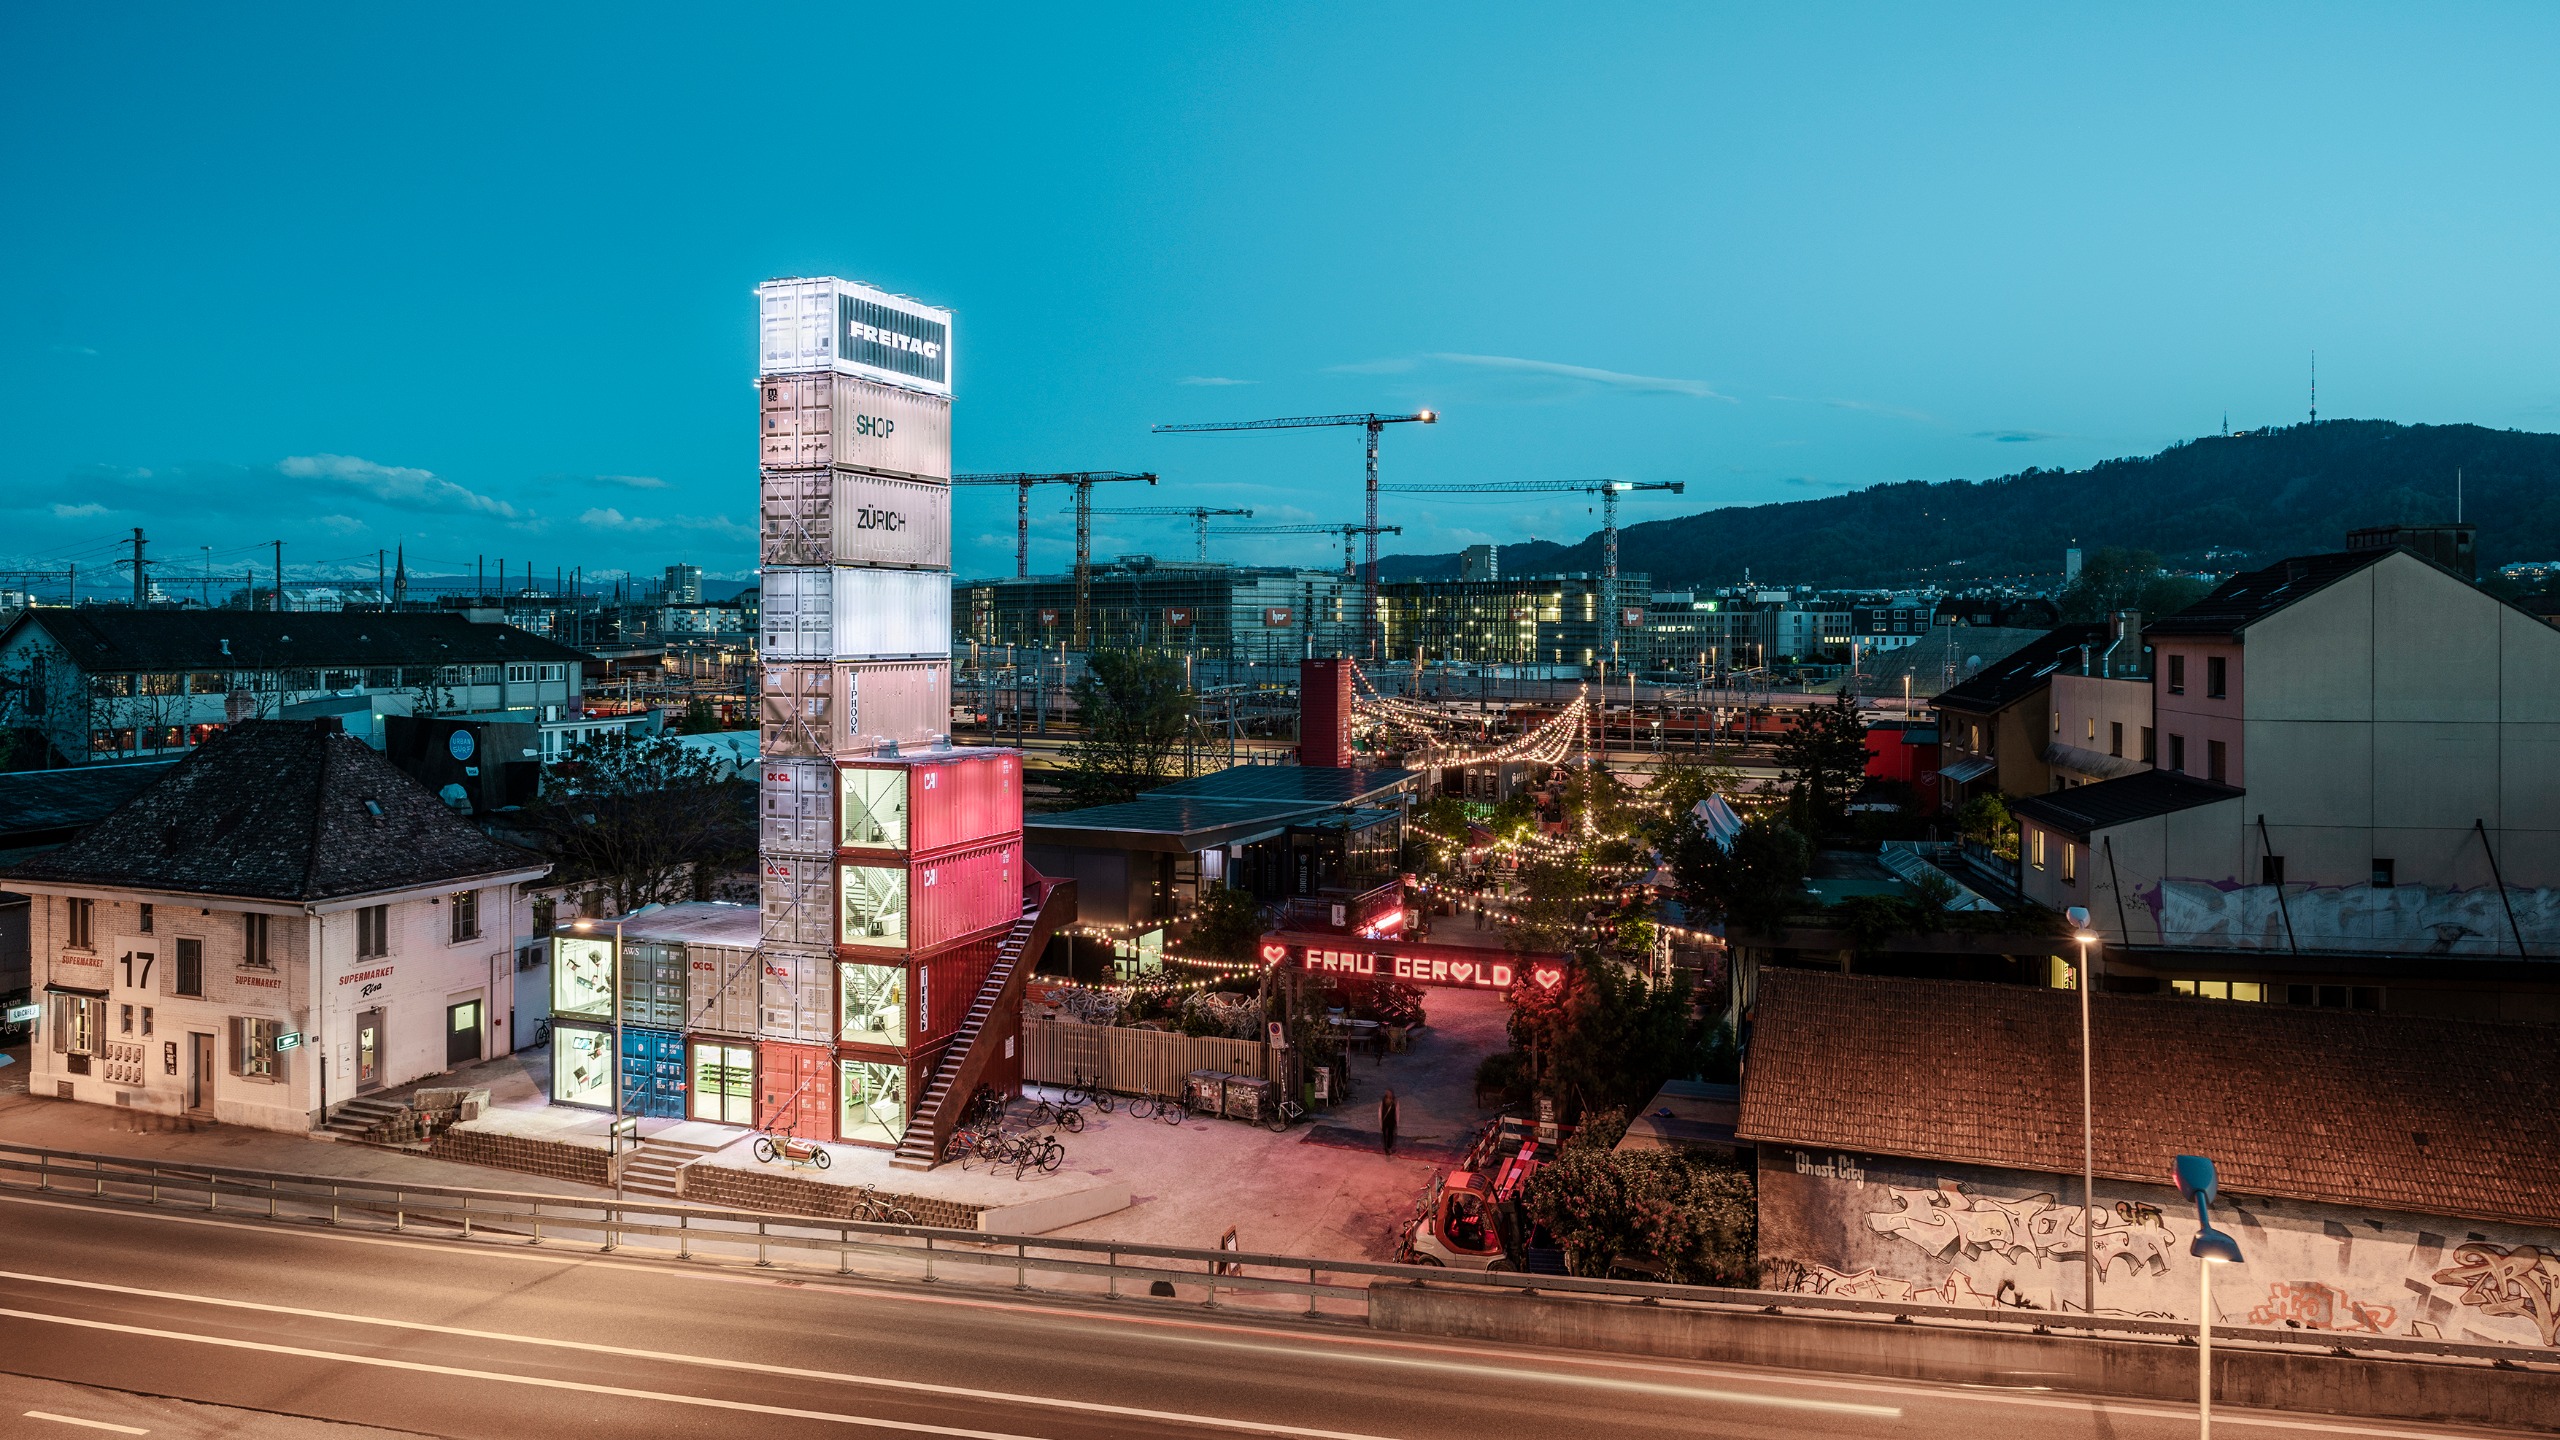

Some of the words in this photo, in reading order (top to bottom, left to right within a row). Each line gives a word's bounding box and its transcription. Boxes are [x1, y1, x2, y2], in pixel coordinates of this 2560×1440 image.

[850, 320, 940, 359] FREITAG
[857, 414, 894, 439] SHOP
[857, 504, 906, 532] ZÜRICH
[850, 673, 858, 735] TIPHOOK
[452, 746, 472, 754] SURF
[62, 955, 104, 968] SUPERMARKET
[120, 951, 154, 989] 17
[1306, 949, 1374, 974] FRAU
[235, 975, 282, 989] SUPERMARKET
[339, 966, 394, 986] SUPERMARKET
